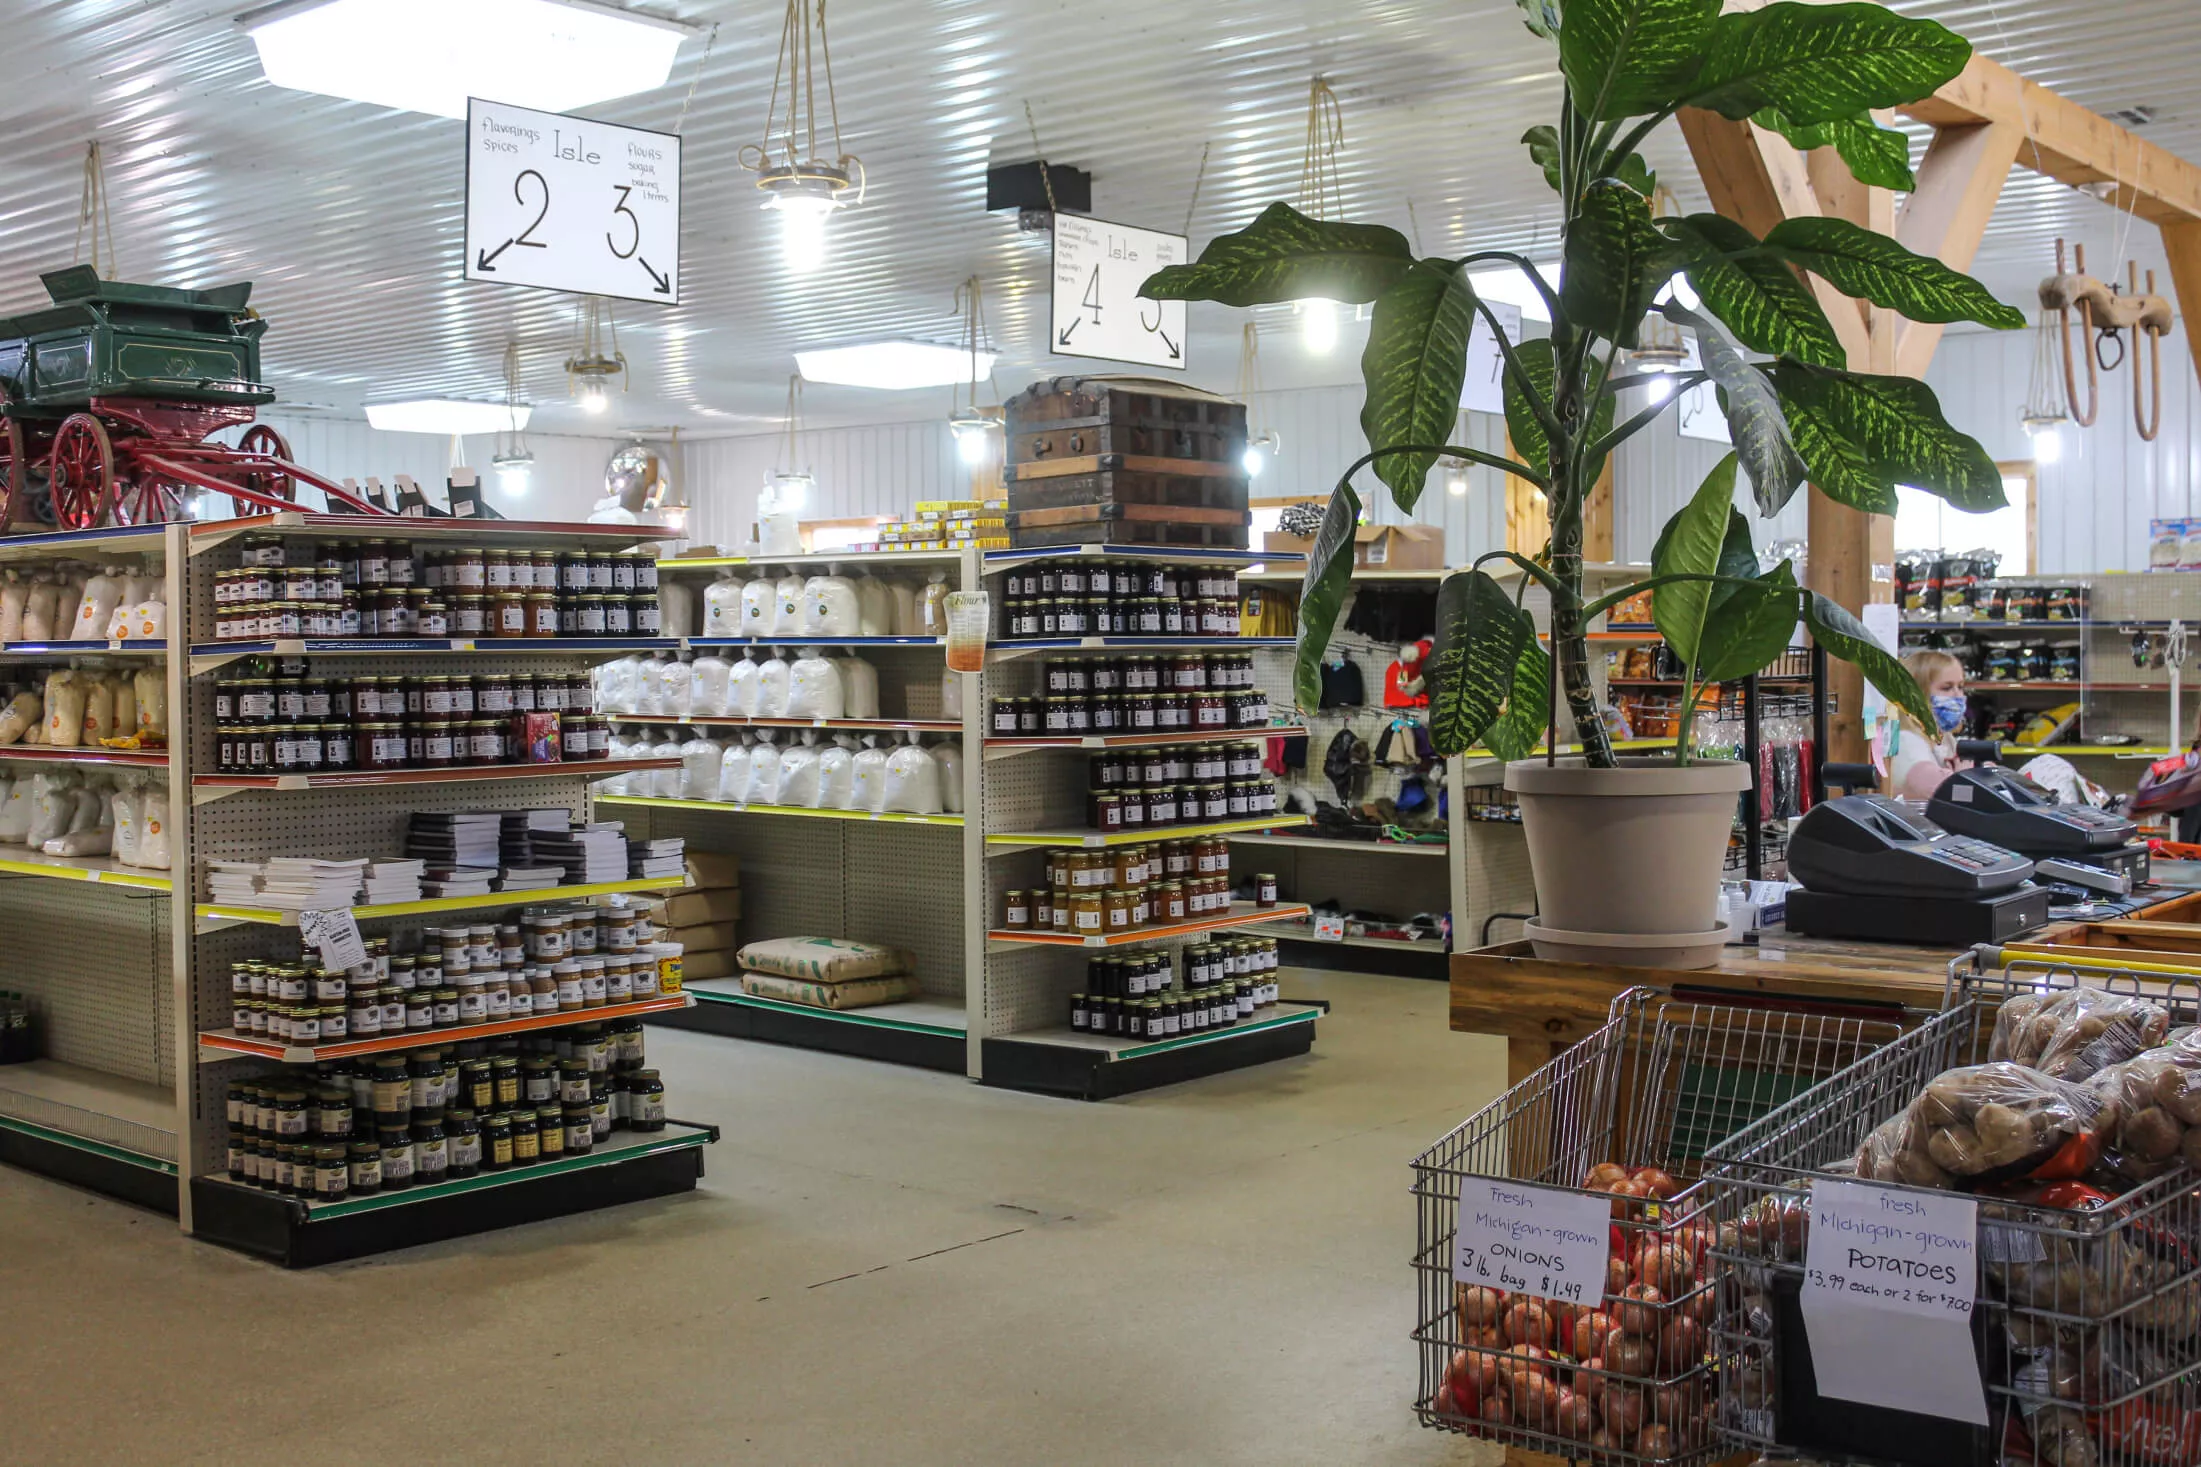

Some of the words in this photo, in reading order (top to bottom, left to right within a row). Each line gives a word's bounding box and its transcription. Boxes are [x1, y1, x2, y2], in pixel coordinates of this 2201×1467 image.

[553, 129, 601, 165] Isle
[514, 169, 549, 248] 2
[606, 184, 640, 260] 3
[1108, 234, 1139, 262] Isle
[1081, 263, 1103, 326] 4
[1490, 1187, 1533, 1208] Fresh
[1880, 1192, 1927, 1216] fresh
[1462, 1248, 1475, 1268] 3
[1500, 1265, 1526, 1290] bag
[1541, 1274, 1582, 1301] $1.49
[1490, 1243, 1565, 1272] ONIONS
[1808, 1269, 1845, 1291] $3.99
[1849, 1281, 1879, 1297] each
[1884, 1288, 1900, 1298] or
[1903, 1290, 1911, 1301] 2
[1916, 1290, 1937, 1304] for
